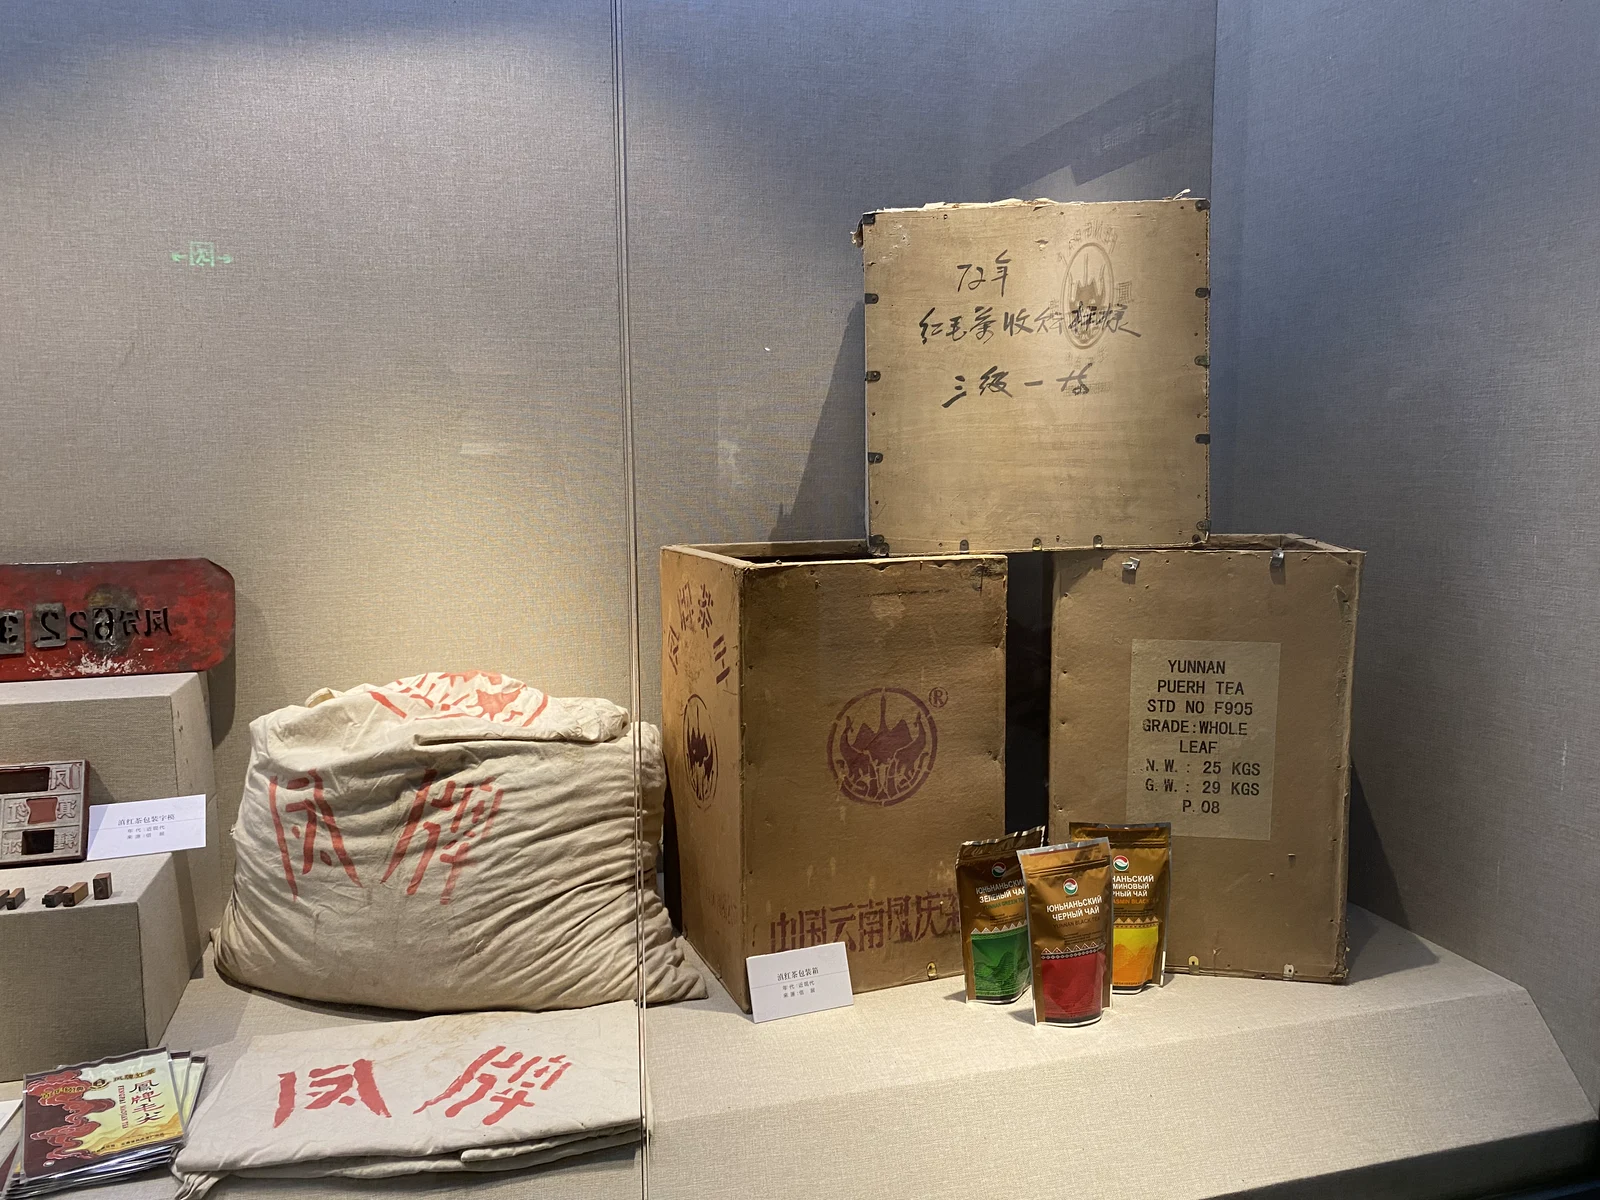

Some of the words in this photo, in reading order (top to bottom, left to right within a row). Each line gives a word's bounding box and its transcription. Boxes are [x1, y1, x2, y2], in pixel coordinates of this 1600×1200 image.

[1168, 660, 1226, 674] YUNNAN
[1157, 680, 1205, 694] PUERH
[1216, 681, 1244, 695] TEA
[1147, 699, 1175, 713] STD
[1185, 700, 1205, 714] NO
[1214, 702, 1253, 715] F905
[1179, 740, 1218, 754] LEAF
[1203, 761, 1221, 774] 25
[1232, 762, 1261, 776] KGS
[1202, 781, 1221, 794] 29
[1231, 782, 1260, 796] KGS
[1046, 895, 1102, 913] ЮНЬНАНЬСКИЙ
[1052, 908, 1083, 921] ЧЕРНЫЙ
[1084, 905, 1100, 915] ЧАЙ
[1075, 918, 1092, 926] BLACK
[273, 1045, 572, 1128] 凤牌
